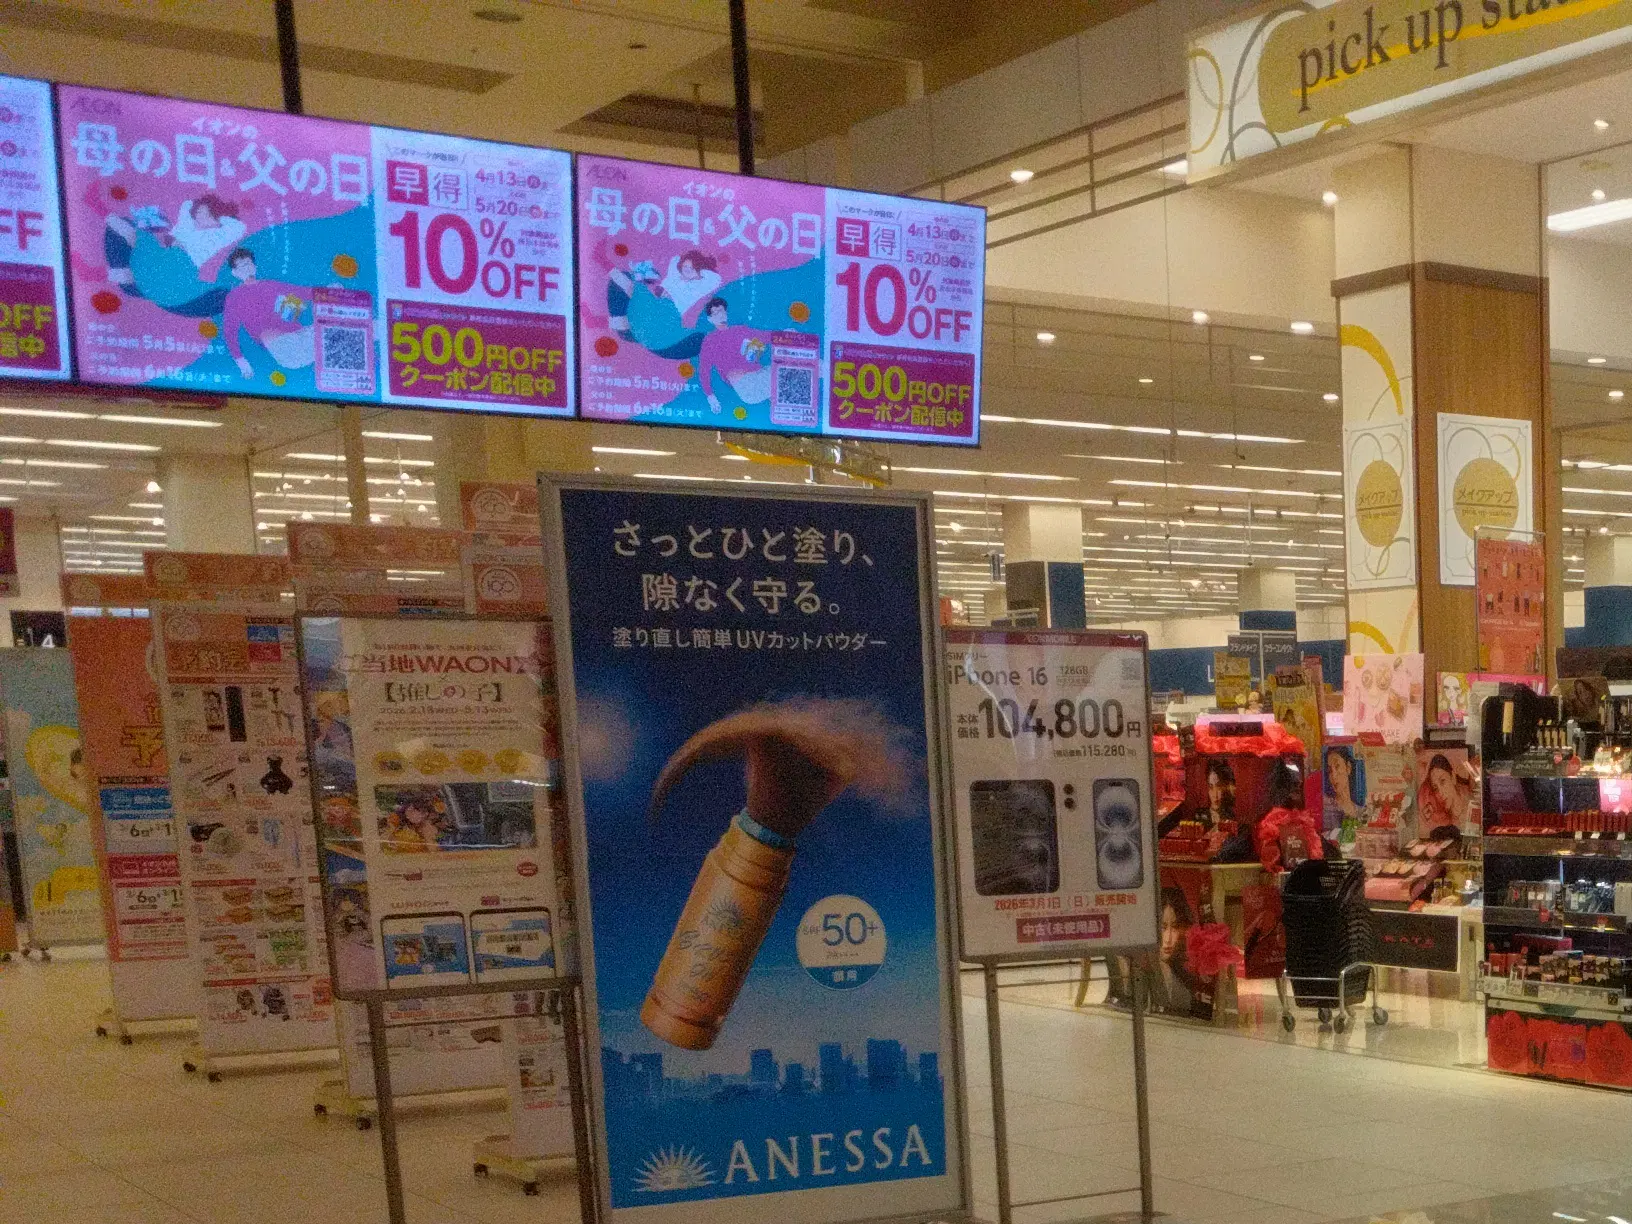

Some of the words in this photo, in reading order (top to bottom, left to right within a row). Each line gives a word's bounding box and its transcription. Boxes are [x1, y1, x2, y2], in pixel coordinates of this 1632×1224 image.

[1297, 6, 1391, 113] pick
[1406, 0, 1465, 68] up
[394, 167, 462, 204] 早得
[841, 223, 897, 257] 早得
[481, 260, 560, 301] OFF
[908, 305, 973, 342] OFF
[391, 322, 562, 373] 500円OFF
[401, 364, 556, 397] クーポン配信中
[832, 361, 972, 405] 500円OFF
[838, 398, 965, 428] クーポン配信中
[1458, 489, 1514, 503] メイクアップ
[613, 519, 874, 567] さっとひと塗り、
[641, 573, 841, 615] 隙なく守る。
[612, 626, 887, 652] 塗り直し簡単UVカットパウダー
[1026, 665, 1050, 687] 16
[723, 1123, 932, 1185] ANESSA
